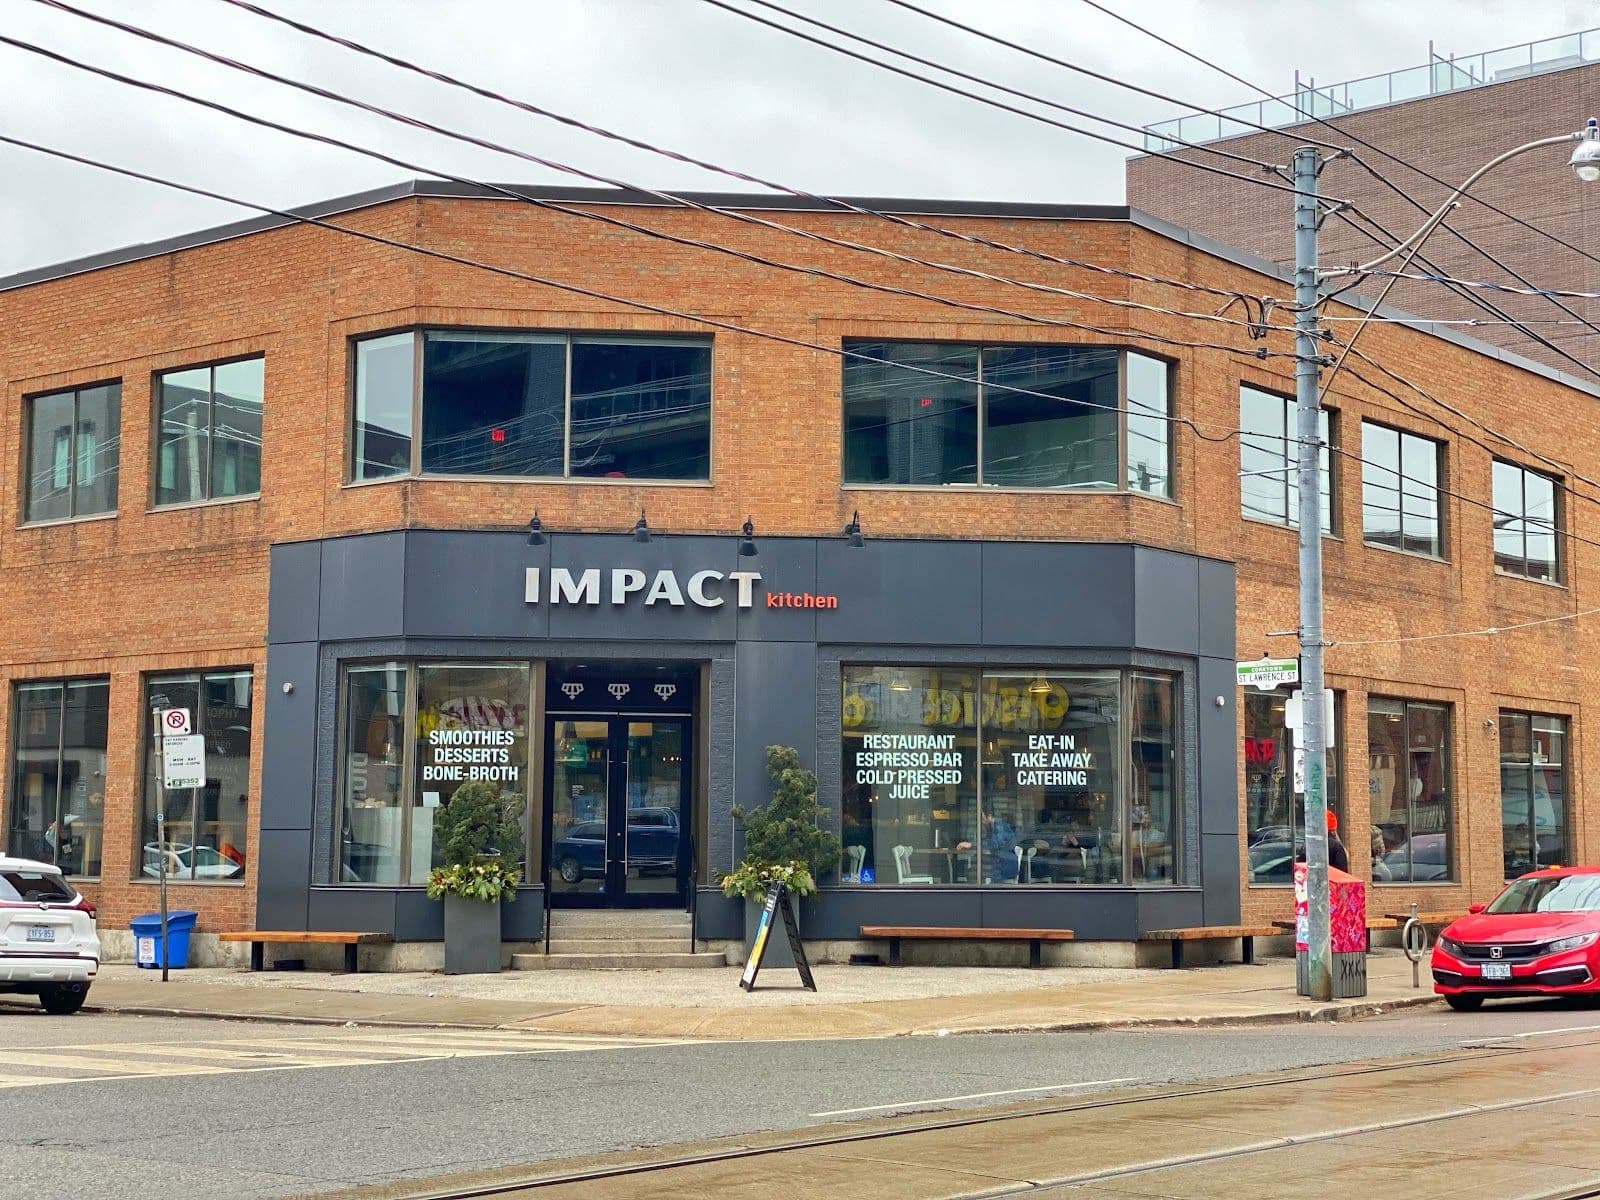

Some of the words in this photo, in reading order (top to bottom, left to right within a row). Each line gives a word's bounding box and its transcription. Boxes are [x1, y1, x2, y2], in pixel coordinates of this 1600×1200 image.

[524, 566, 762, 609] IMPACT
[767, 590, 839, 610] kitchen
[1238, 674, 1247, 684] ST
[1249, 672, 1285, 682] LAWRENCE
[1287, 671, 1296, 681] ST
[429, 730, 515, 746] SMOOTHIES
[863, 734, 956, 750] RESTAURANT
[1028, 734, 1075, 750] EAT-IN
[434, 748, 509, 763] DESSERTS
[855, 752, 928, 768] ESPRESSO
[933, 752, 963, 768] BAR
[1012, 753, 1051, 768] TAKE
[1052, 753, 1092, 768] AWAY
[423, 765, 519, 781] BONE-BROTH
[856, 770, 893, 785] COLD
[897, 770, 962, 785] PRESSED
[1017, 770, 1087, 786] CATERING
[889, 784, 930, 800] JUICE
